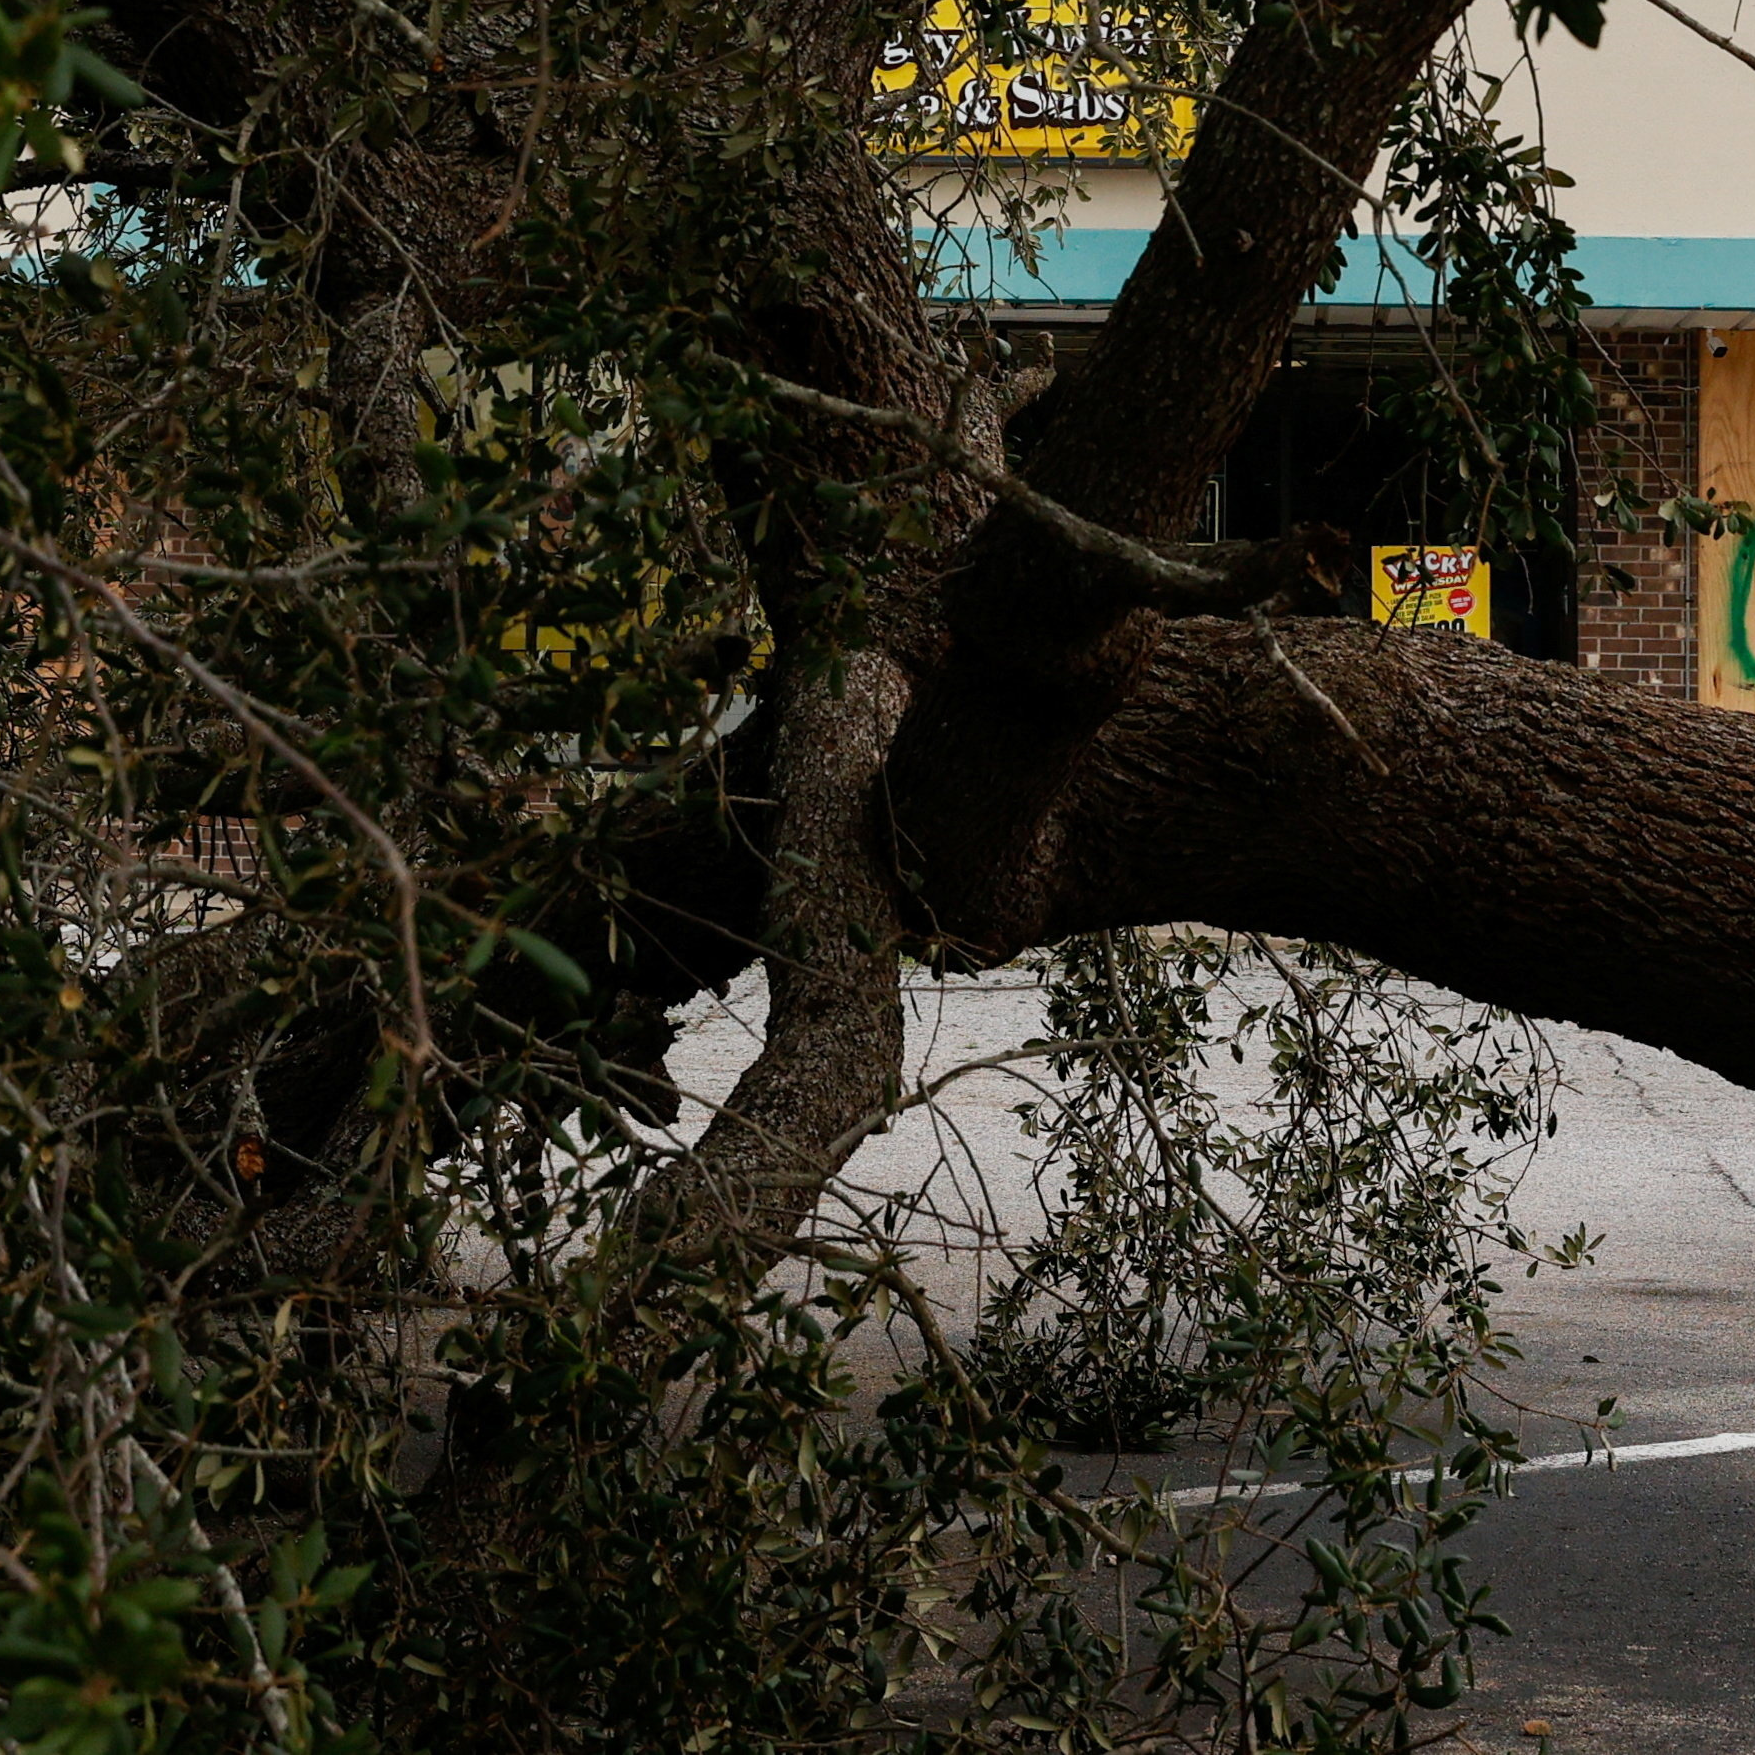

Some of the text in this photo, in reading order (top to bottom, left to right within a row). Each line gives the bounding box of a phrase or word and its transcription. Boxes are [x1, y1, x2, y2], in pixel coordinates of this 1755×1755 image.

[1012, 72, 1125, 120] Subs
[1384, 552, 1473, 577] WCKY
[1394, 574, 1469, 592] WESDAY
